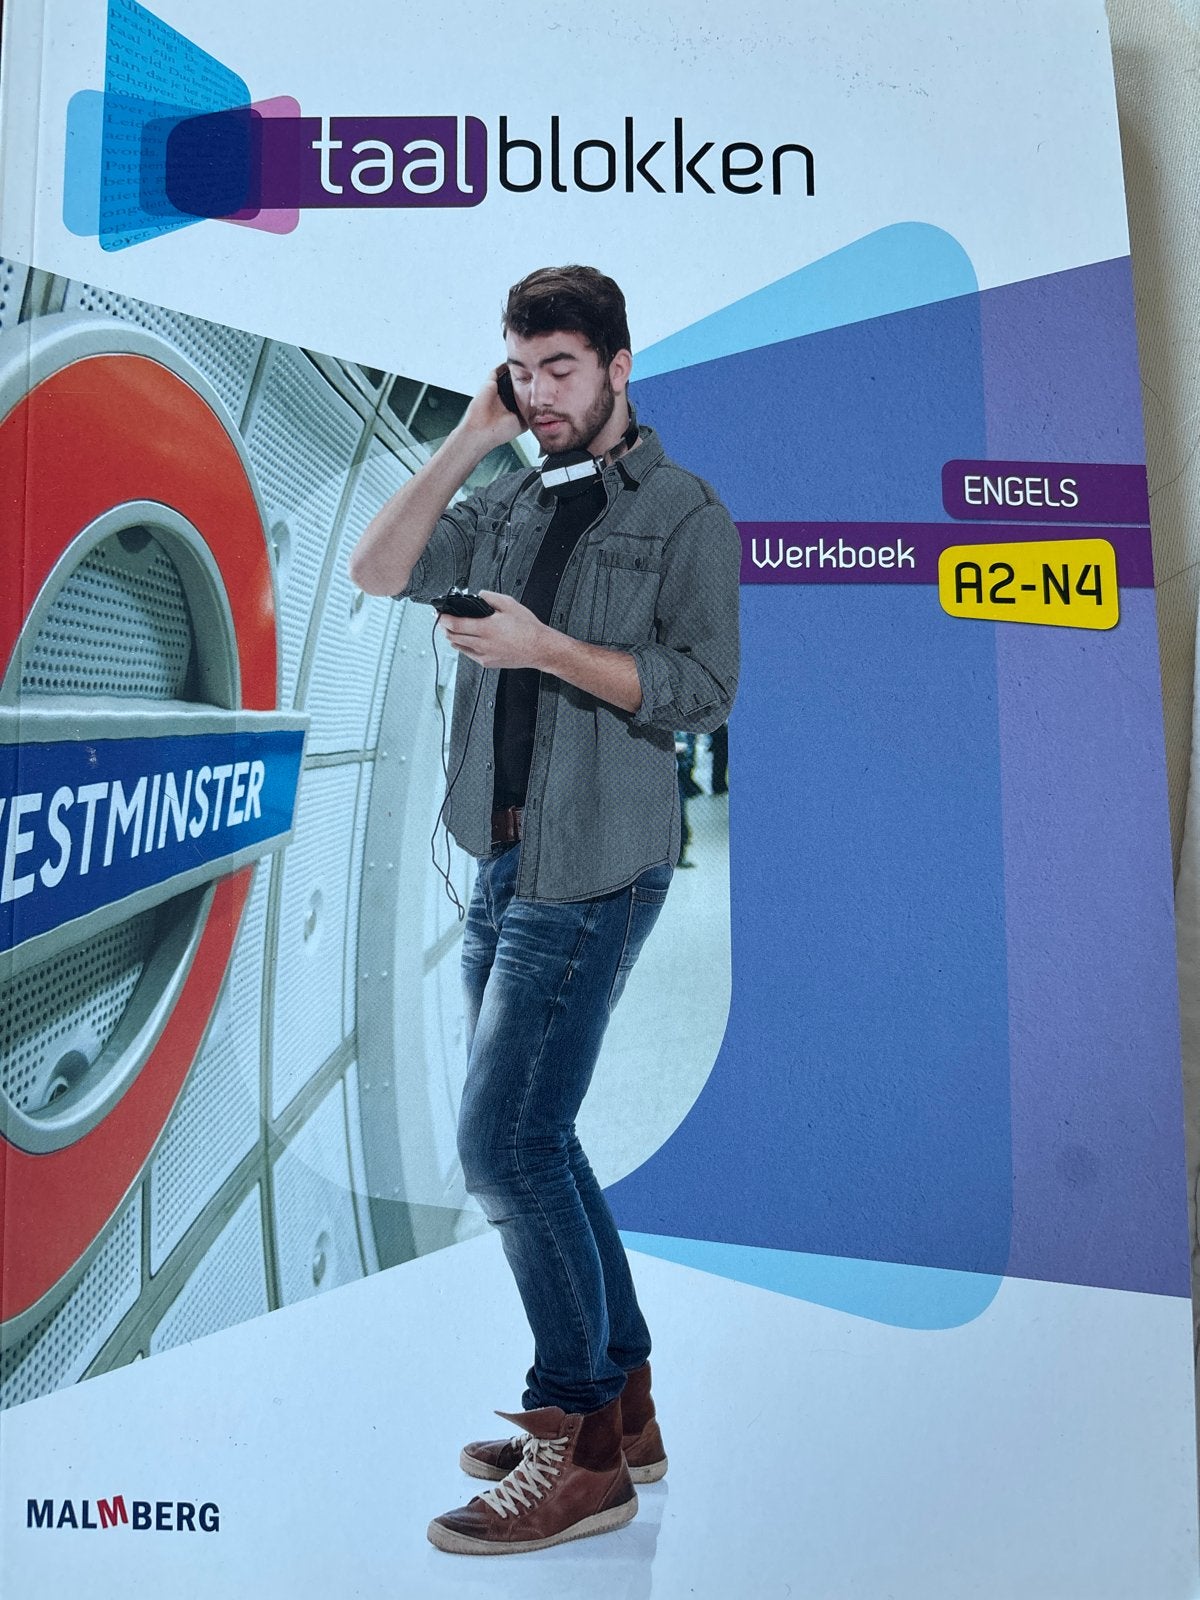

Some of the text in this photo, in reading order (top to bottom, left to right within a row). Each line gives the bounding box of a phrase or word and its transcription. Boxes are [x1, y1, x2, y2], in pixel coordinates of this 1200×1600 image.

[107, 54, 141, 73] dan
[312, 115, 474, 195] taal
[499, 115, 815, 197] blokken
[964, 475, 1080, 508] ENGELS
[751, 538, 916, 569] Werkboek
[954, 561, 1104, 606] A2-N4
[0, 760, 265, 902] ESTMINSTER
[26, 1495, 221, 1533] MALMBERG
